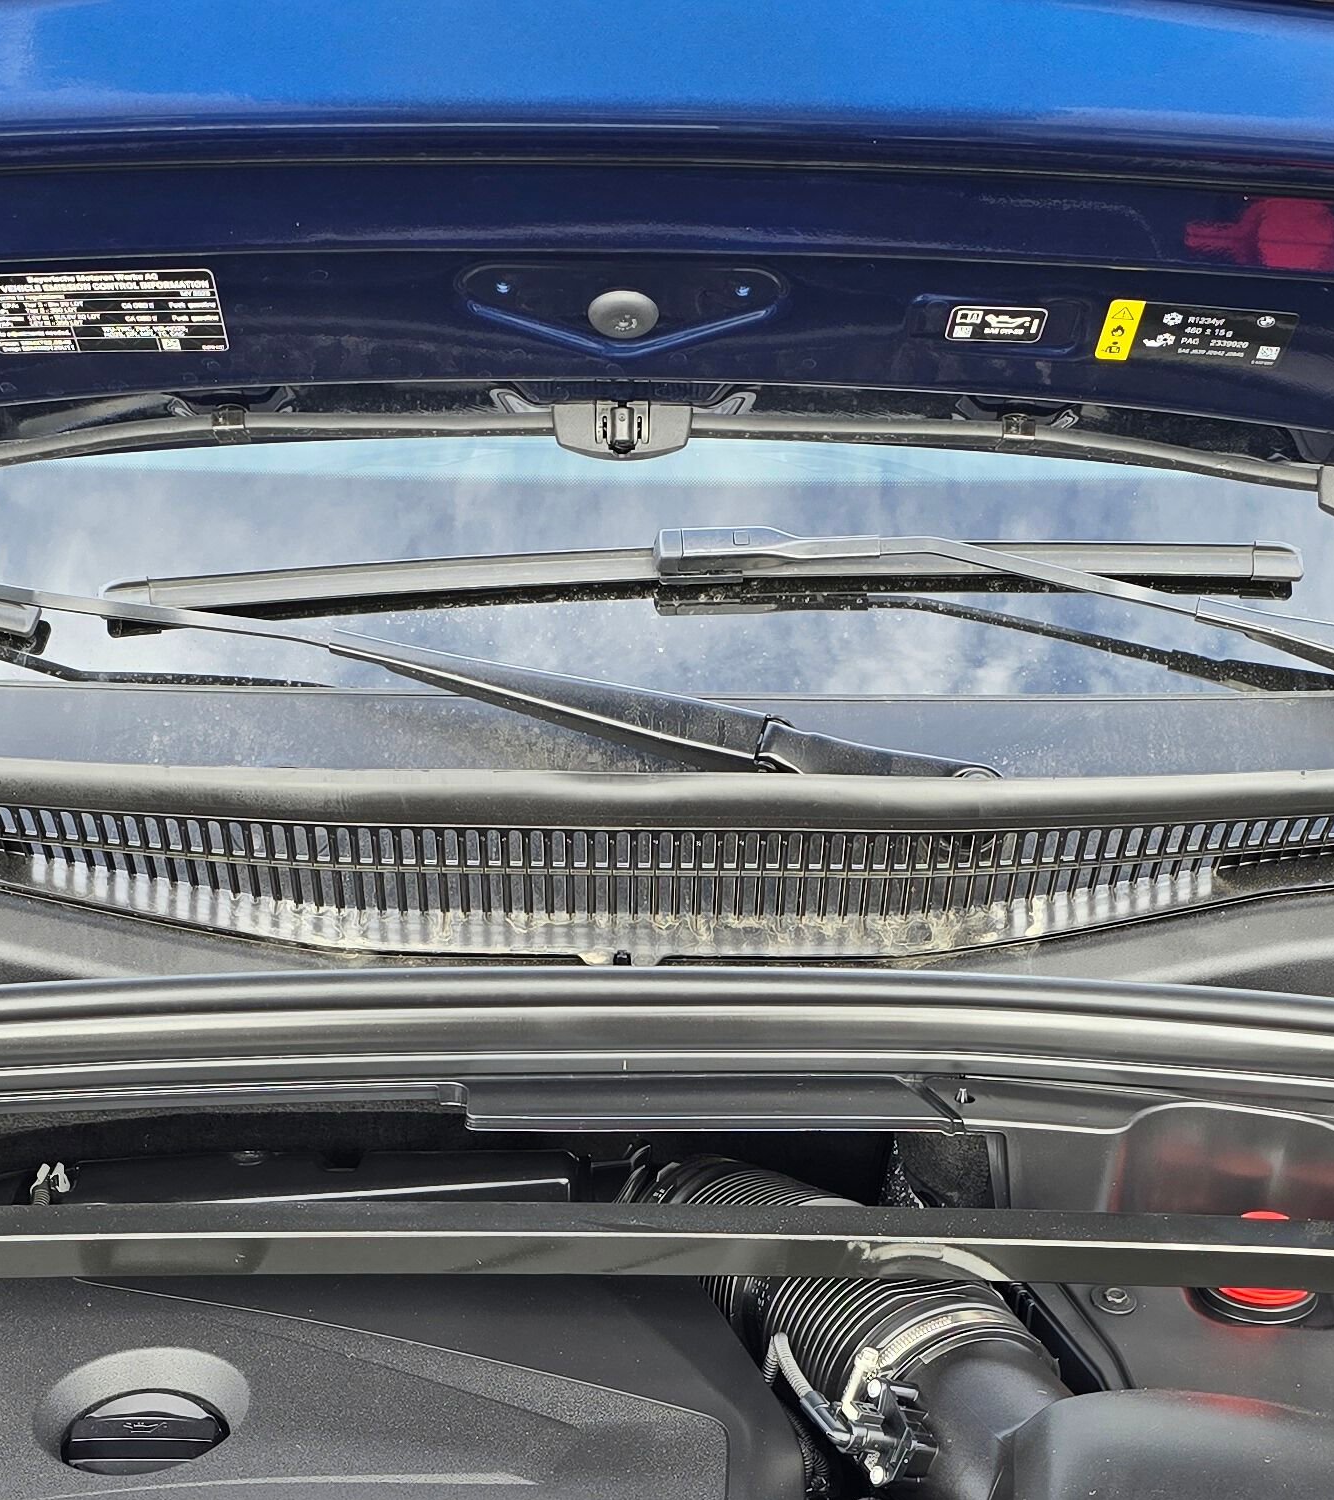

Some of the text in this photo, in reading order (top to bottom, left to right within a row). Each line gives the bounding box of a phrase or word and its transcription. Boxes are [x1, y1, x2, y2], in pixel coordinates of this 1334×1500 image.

[0, 284, 42, 293] VEHICLE
[92, 281, 139, 291] CONTROL
[140, 279, 209, 290] INFORMATION
[1188, 316, 1226, 326] R1234yf
[1180, 337, 1199, 346] PAG
